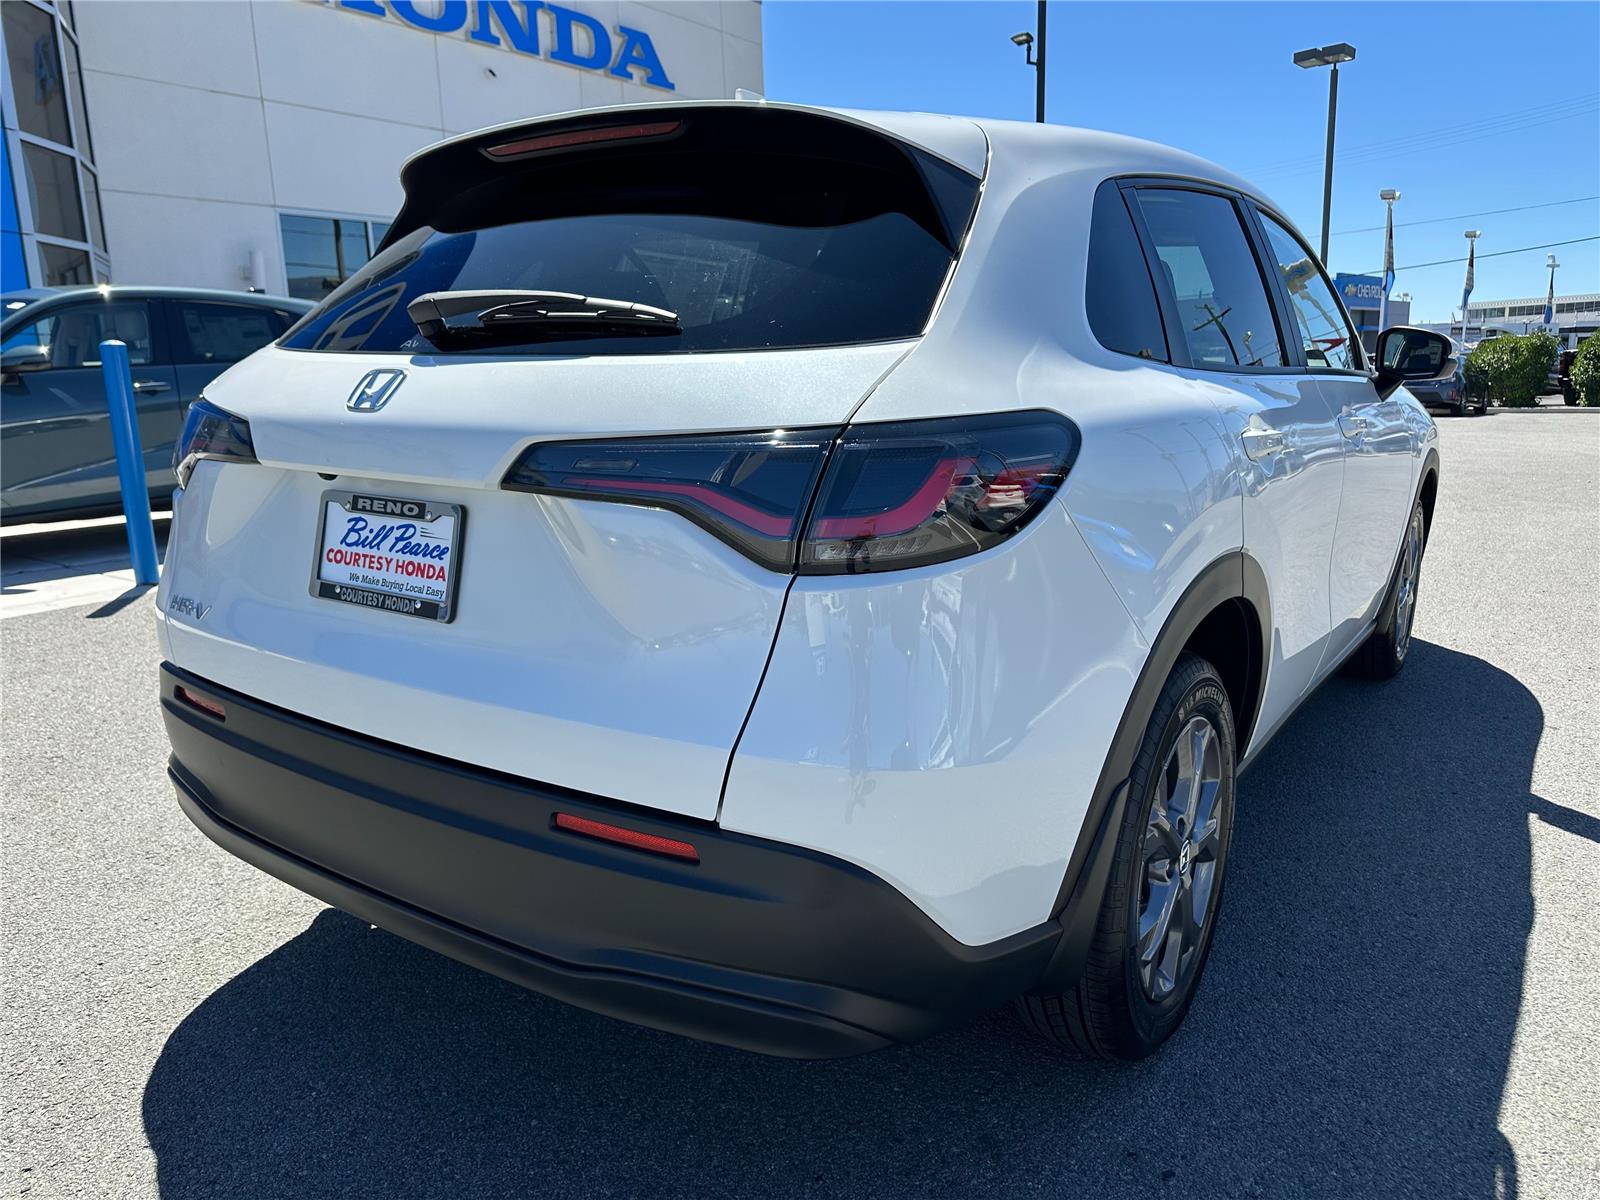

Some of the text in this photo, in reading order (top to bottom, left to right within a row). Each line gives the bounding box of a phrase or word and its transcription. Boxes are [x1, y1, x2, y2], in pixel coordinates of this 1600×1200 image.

[328, 0, 675, 91] ONDA
[357, 498, 419, 516] RENO
[339, 516, 450, 561] Bill Pearce
[326, 547, 446, 582] COURTESY HONDA
[349, 572, 445, 599] We Make Buying Local Easy
[340, 587, 415, 614] COURTESY HONDA
[1195, 686, 1224, 706] MICHELIN
